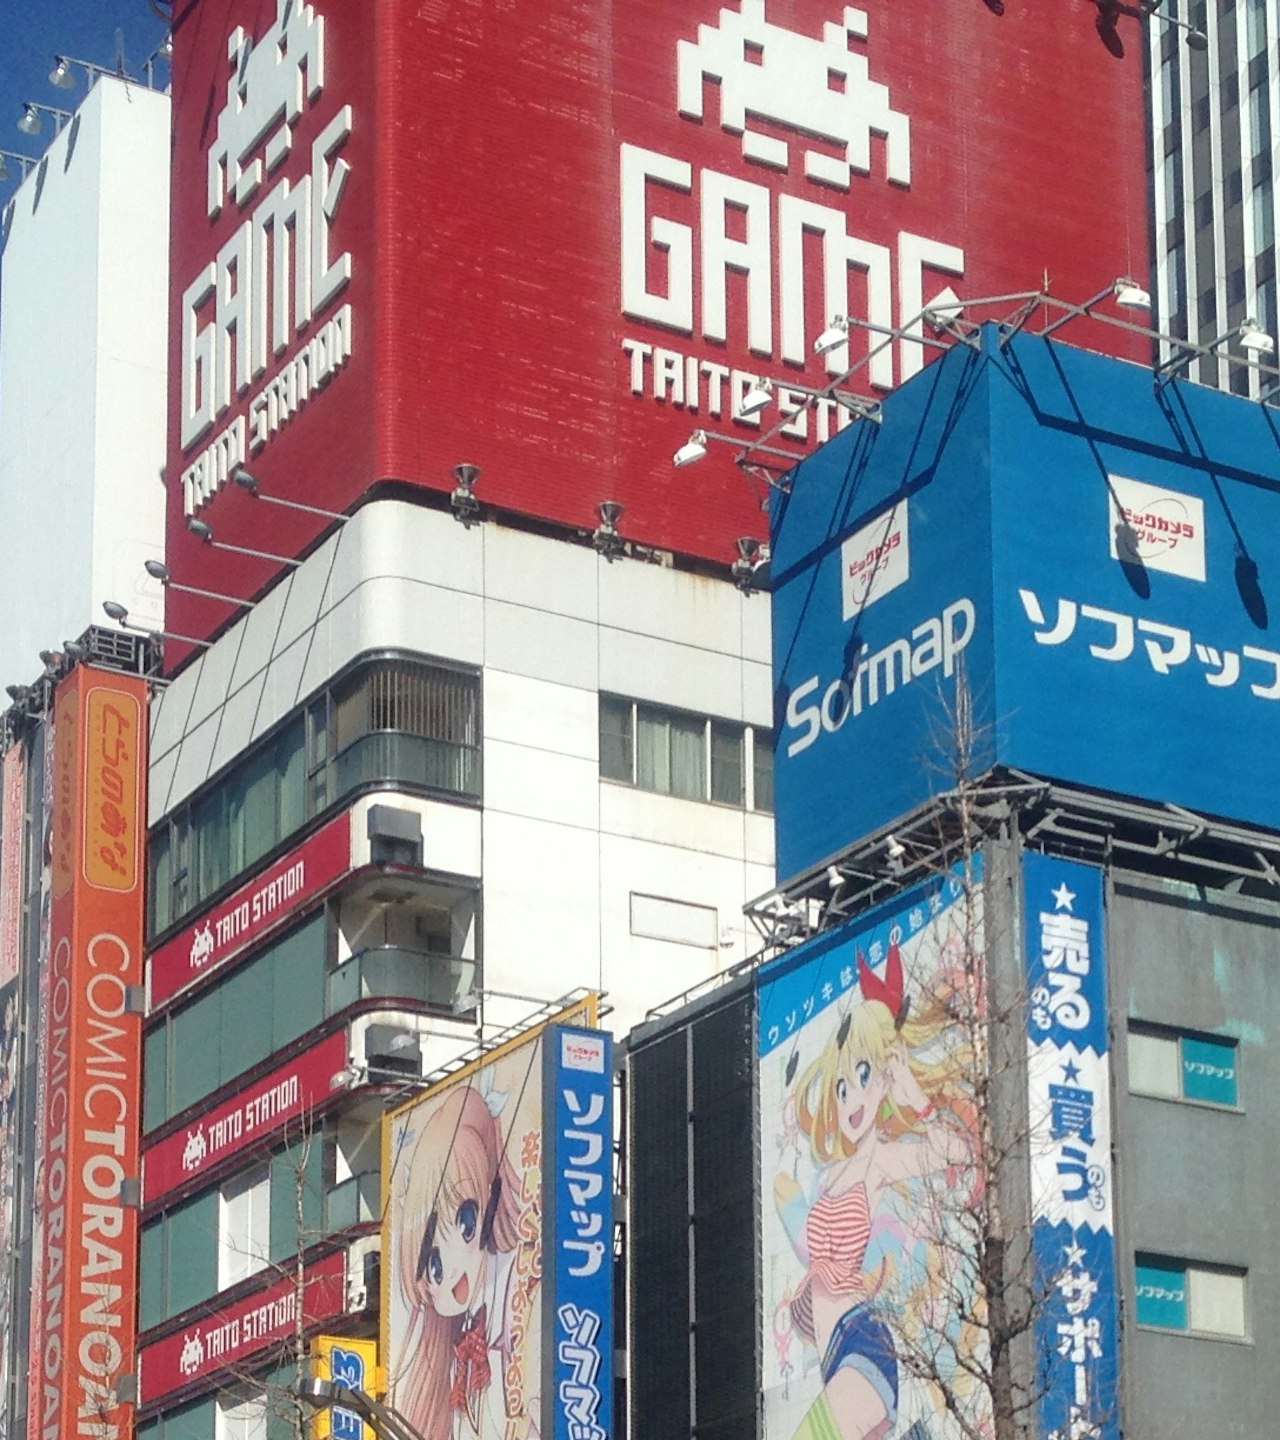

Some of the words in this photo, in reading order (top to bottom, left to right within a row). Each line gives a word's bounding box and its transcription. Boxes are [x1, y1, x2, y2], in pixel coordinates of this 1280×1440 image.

[181, 104, 352, 452] GAME
[181, 414, 247, 518] TAITO
[249, 303, 352, 453] STATION
[784, 597, 977, 758] Sofmap
[215, 903, 251, 949] TAITO
[252, 859, 305, 922] STATION
[209, 1112, 244, 1154] TAITO
[245, 1073, 298, 1129] STATION
[1183, 1060, 1234, 1081] ソフマップ
[562, 1088, 606, 1278] ソフマップ
[204, 1318, 240, 1359] TAITO
[243, 1289, 297, 1343] STATION
[1135, 1284, 1184, 1302] ソフマップ
